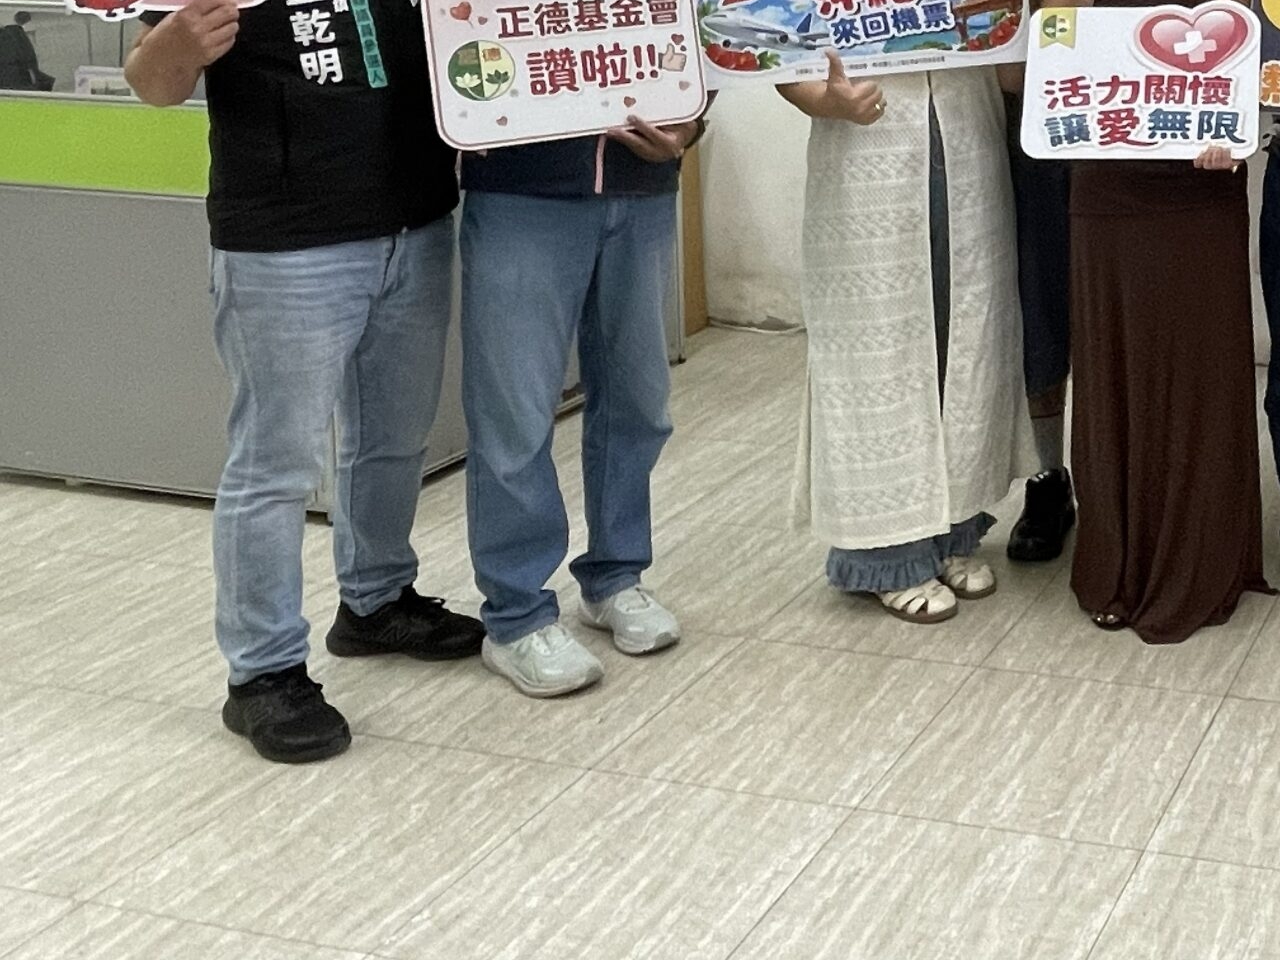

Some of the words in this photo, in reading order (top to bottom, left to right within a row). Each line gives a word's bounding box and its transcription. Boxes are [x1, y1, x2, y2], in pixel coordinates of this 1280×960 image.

[832, 2, 953, 44] 來回機票
[526, 42, 659, 96] 讚啦!!
[1044, 74, 1233, 110] 活力關懷
[1044, 107, 1247, 147] 讓愛無限
